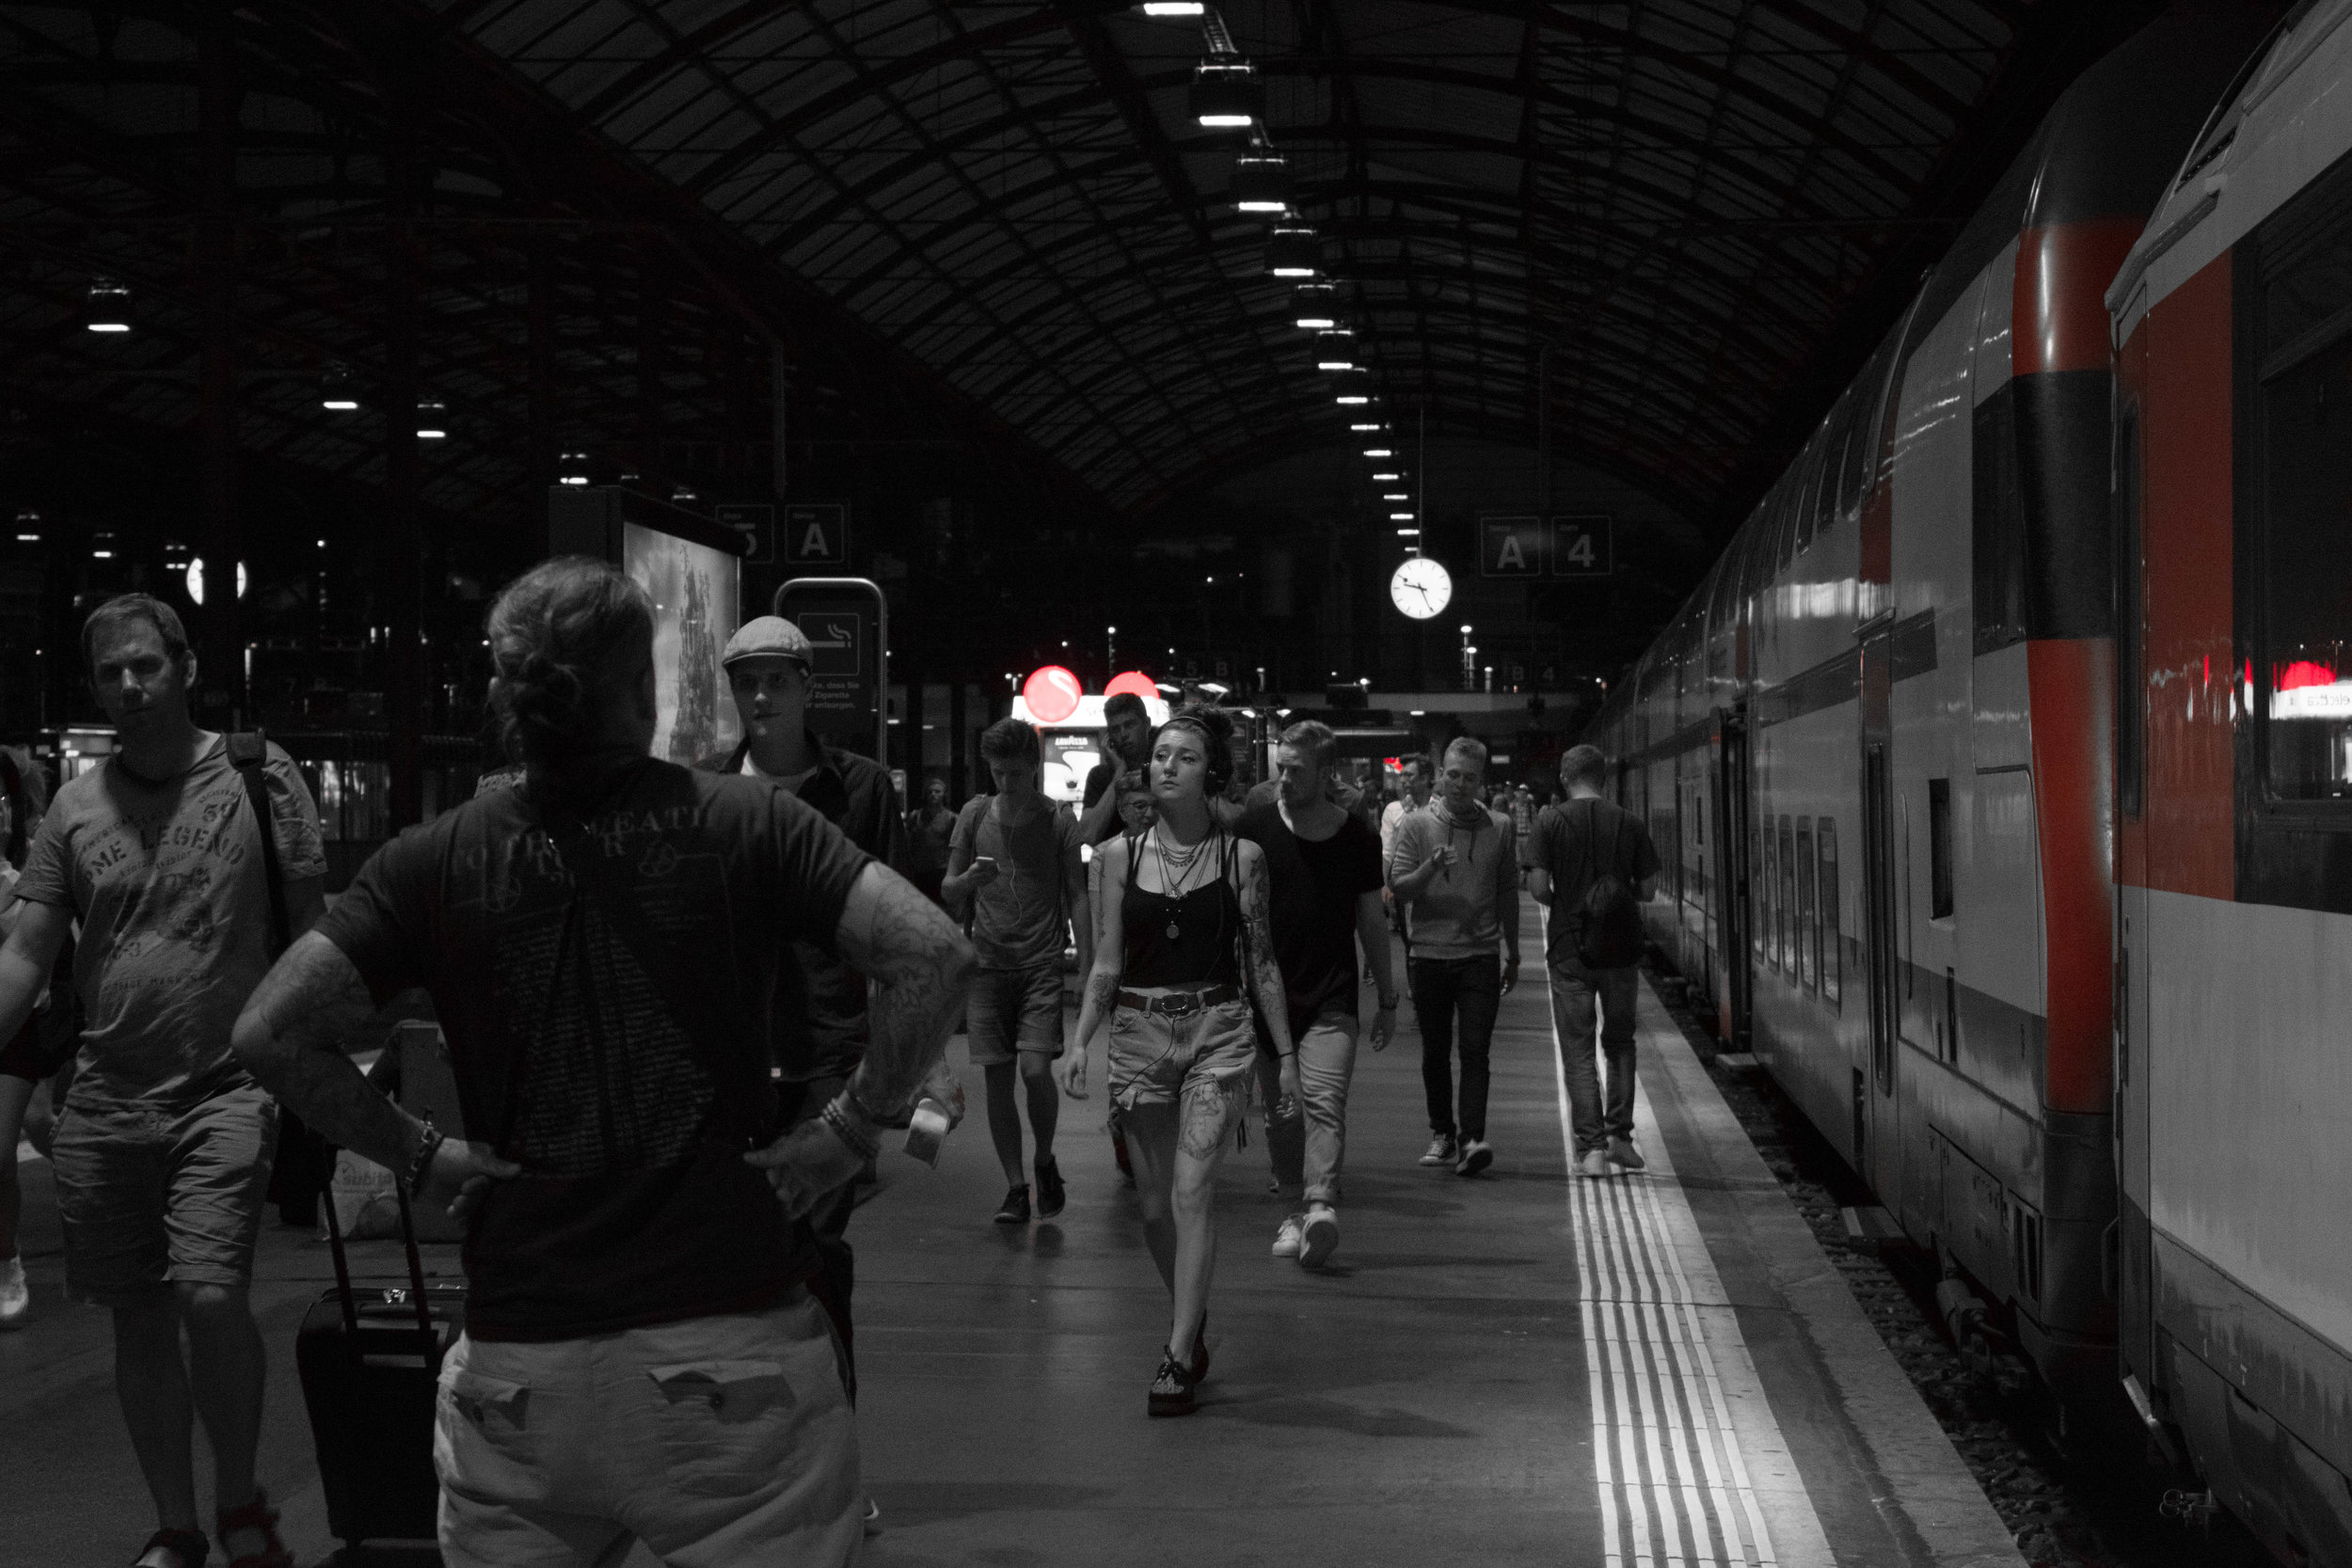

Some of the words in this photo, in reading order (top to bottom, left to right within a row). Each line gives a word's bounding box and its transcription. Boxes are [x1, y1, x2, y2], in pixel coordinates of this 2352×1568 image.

[800, 522, 830, 557] A
[1496, 534, 1526, 570] A
[1566, 533, 1596, 568] 4
[139, 824, 245, 865] LEGEND
